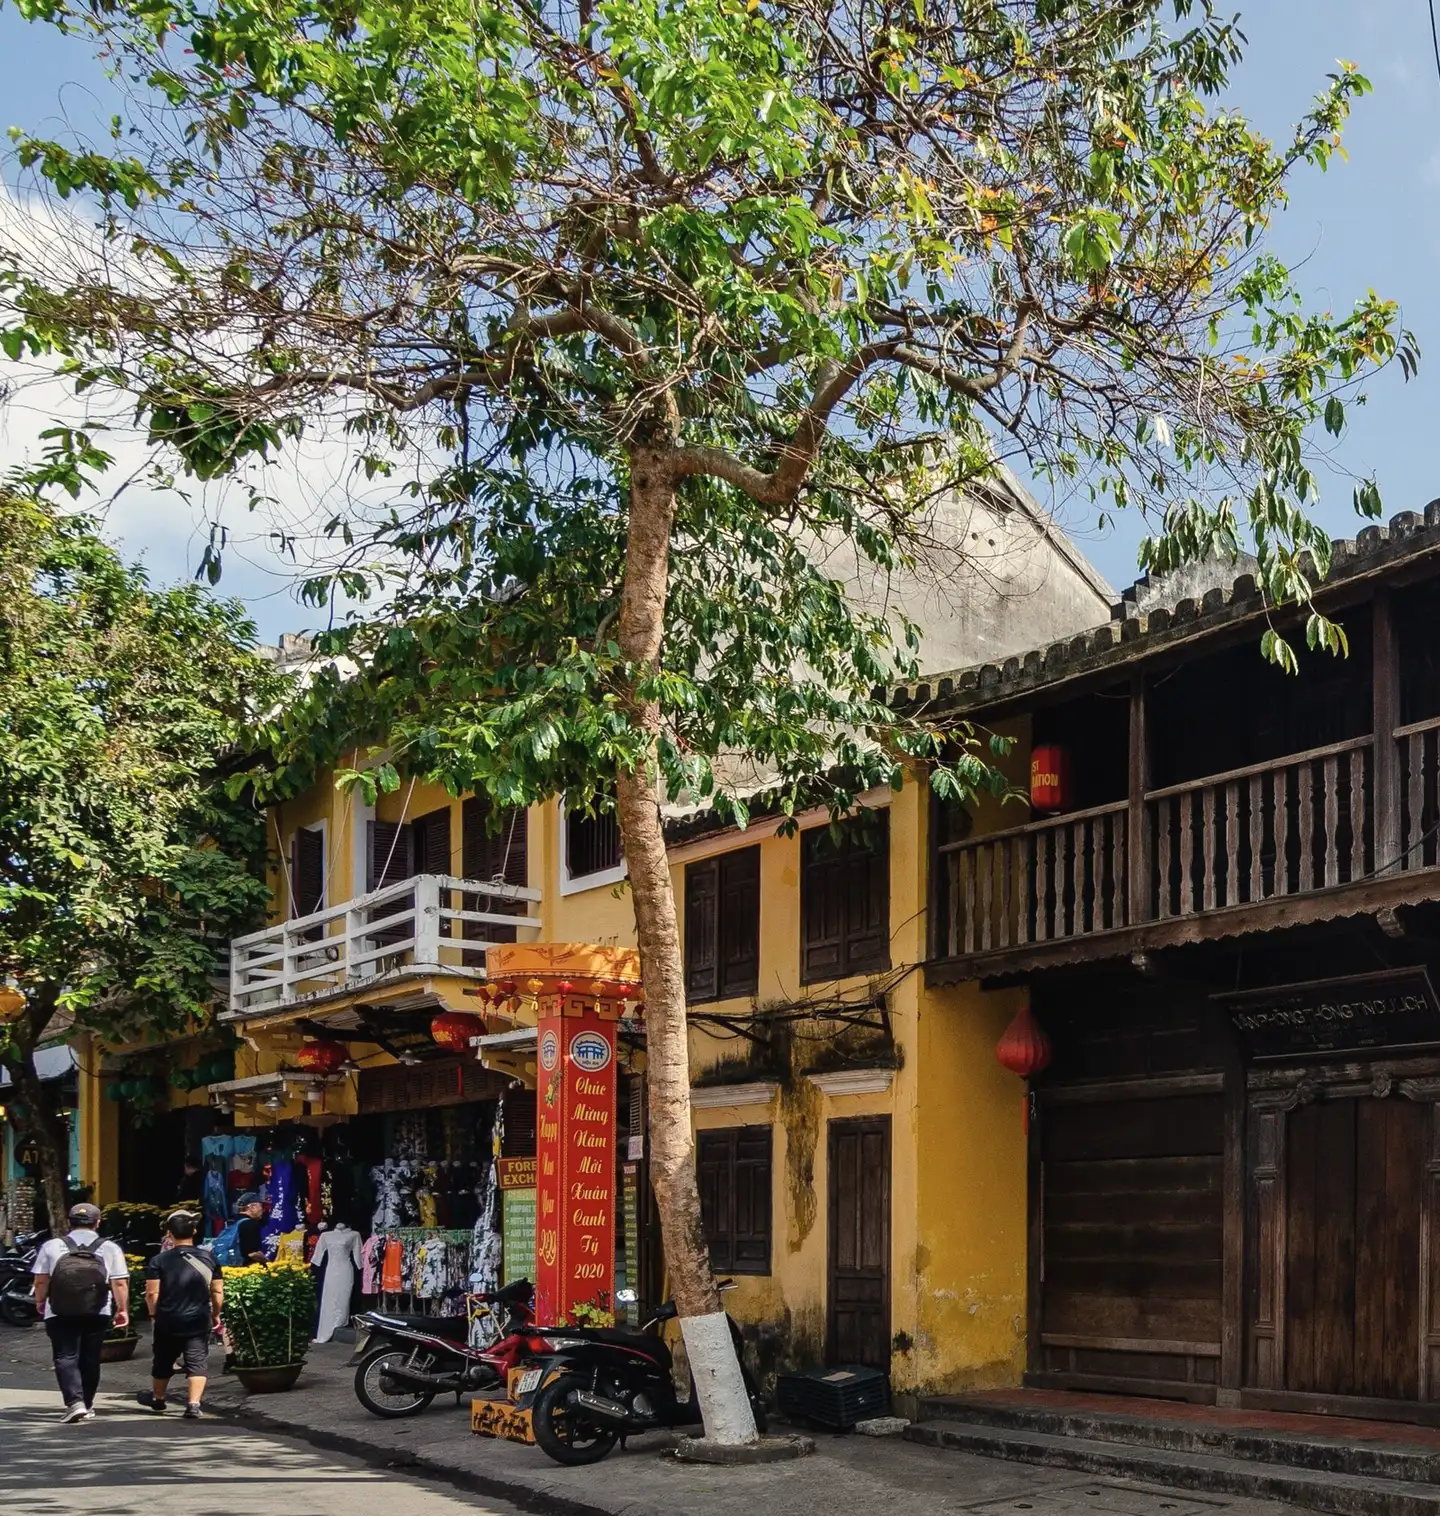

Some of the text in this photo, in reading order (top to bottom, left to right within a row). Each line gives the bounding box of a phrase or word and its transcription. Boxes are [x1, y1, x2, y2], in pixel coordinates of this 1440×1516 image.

[575, 1077, 606, 1096] Chúc
[571, 1103, 608, 1126] Mừng
[573, 1129, 607, 1148] Năm
[576, 1155, 603, 1174] Mới
[503, 1174, 537, 1186] EXCH
[570, 1182, 608, 1200] Xuân
[573, 1208, 606, 1227] Canh
[580, 1234, 599, 1256] Tý
[573, 1263, 605, 1279] 2020
